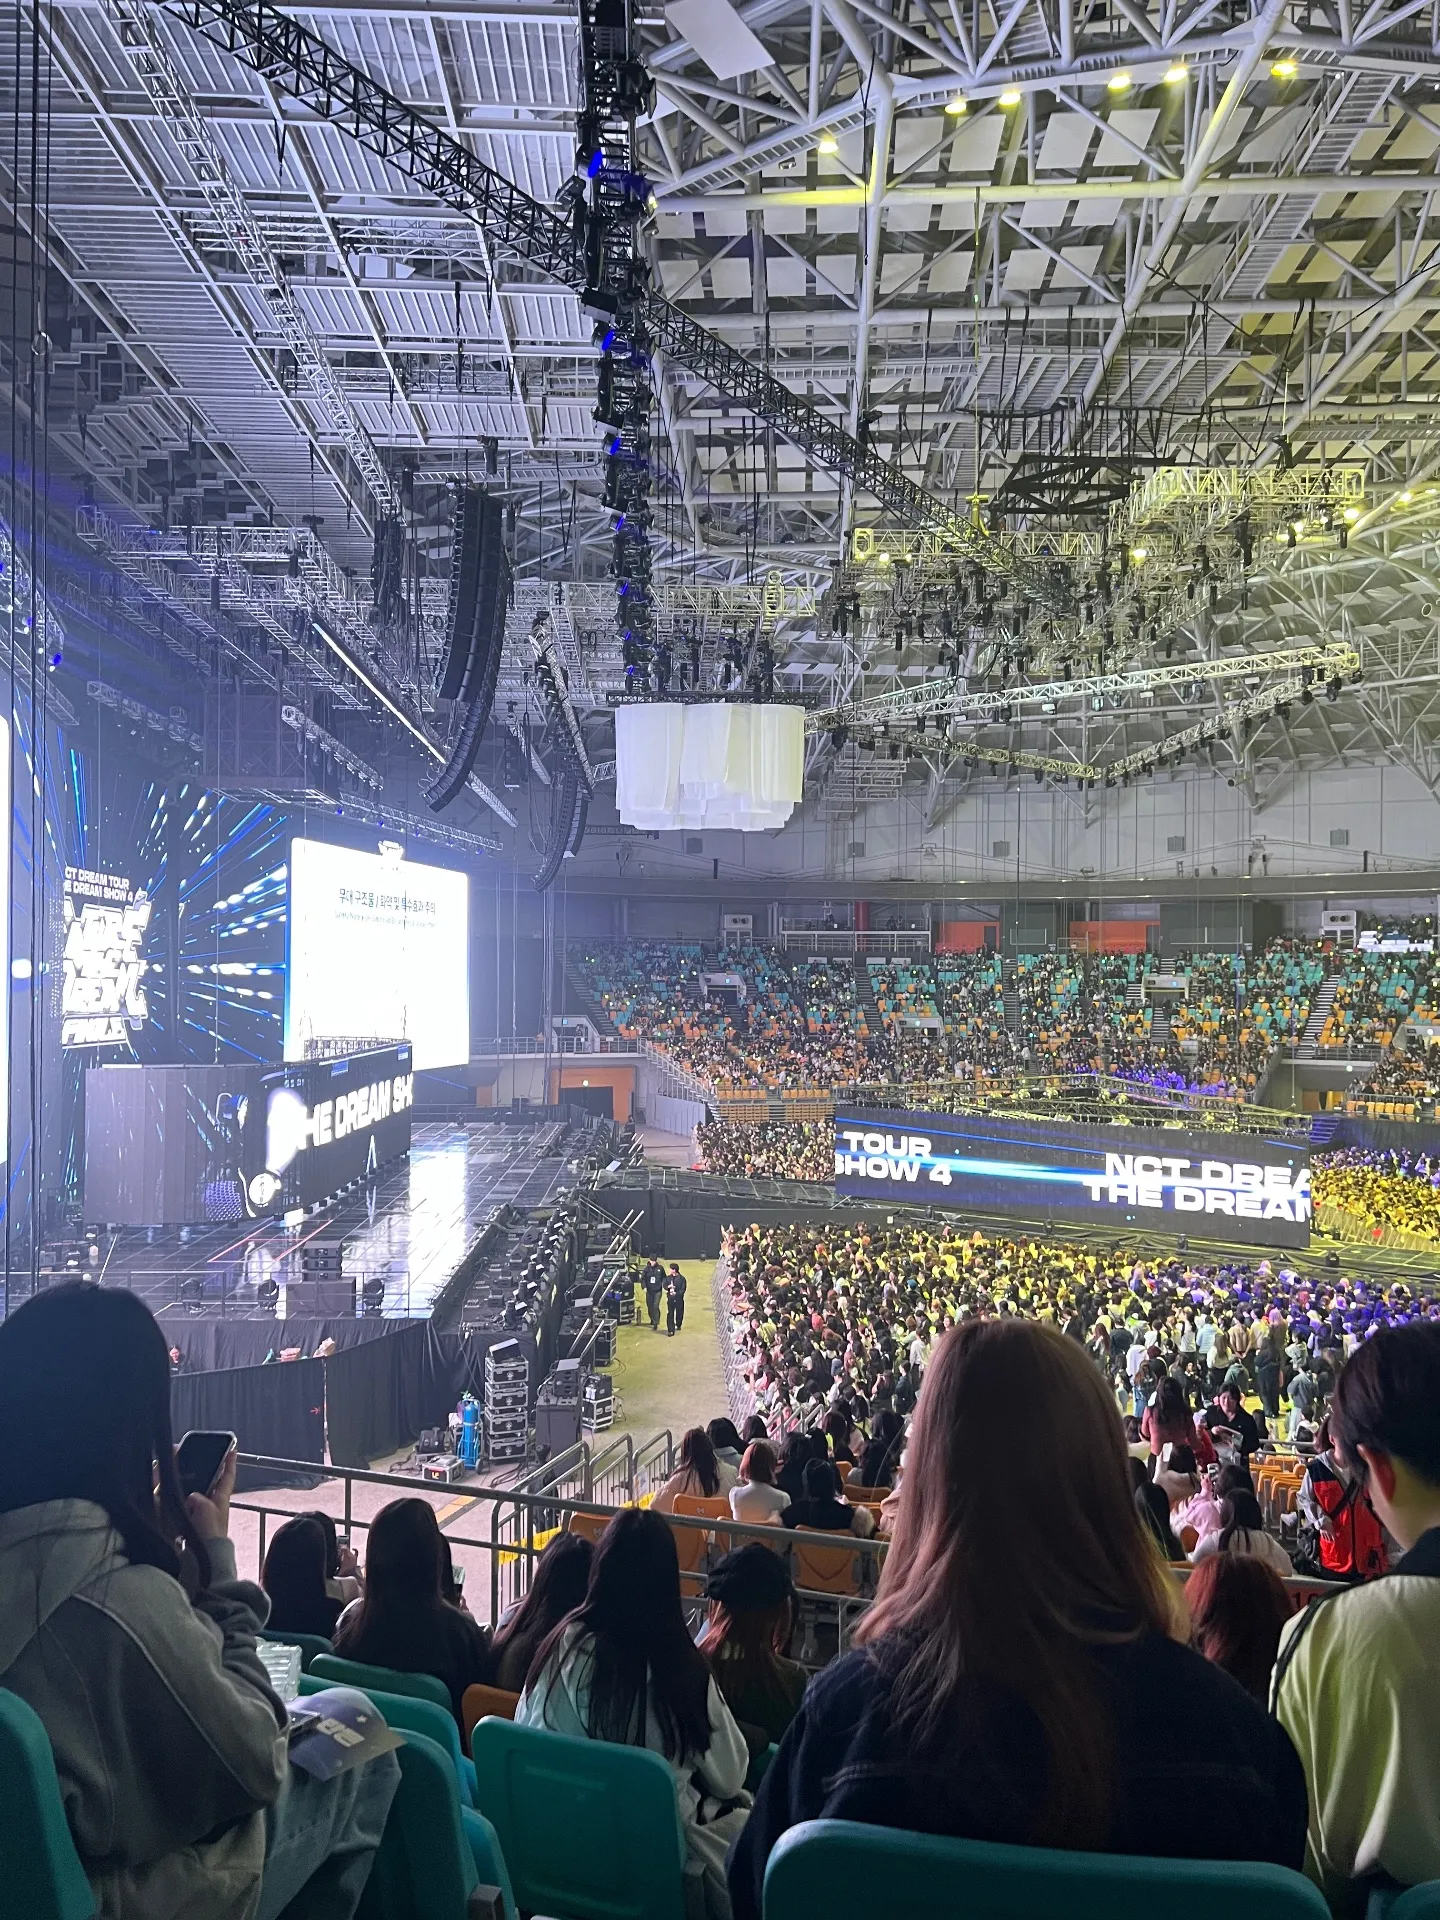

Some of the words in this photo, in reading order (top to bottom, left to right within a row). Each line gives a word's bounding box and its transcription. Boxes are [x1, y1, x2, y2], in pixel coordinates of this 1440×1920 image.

[73, 881, 103, 898] DREAM
[103, 886, 127, 902] SHOW
[127, 892, 133, 903] 4
[78, 869, 108, 886] DREAM
[108, 875, 130, 890] TOUR
[335, 1080, 391, 1139] DREAM
[843, 1130, 932, 1159] TOUR
[929, 1163, 953, 1186] 4
[1105, 1152, 1191, 1182] NCT
[1083, 1176, 1163, 1208] THE
